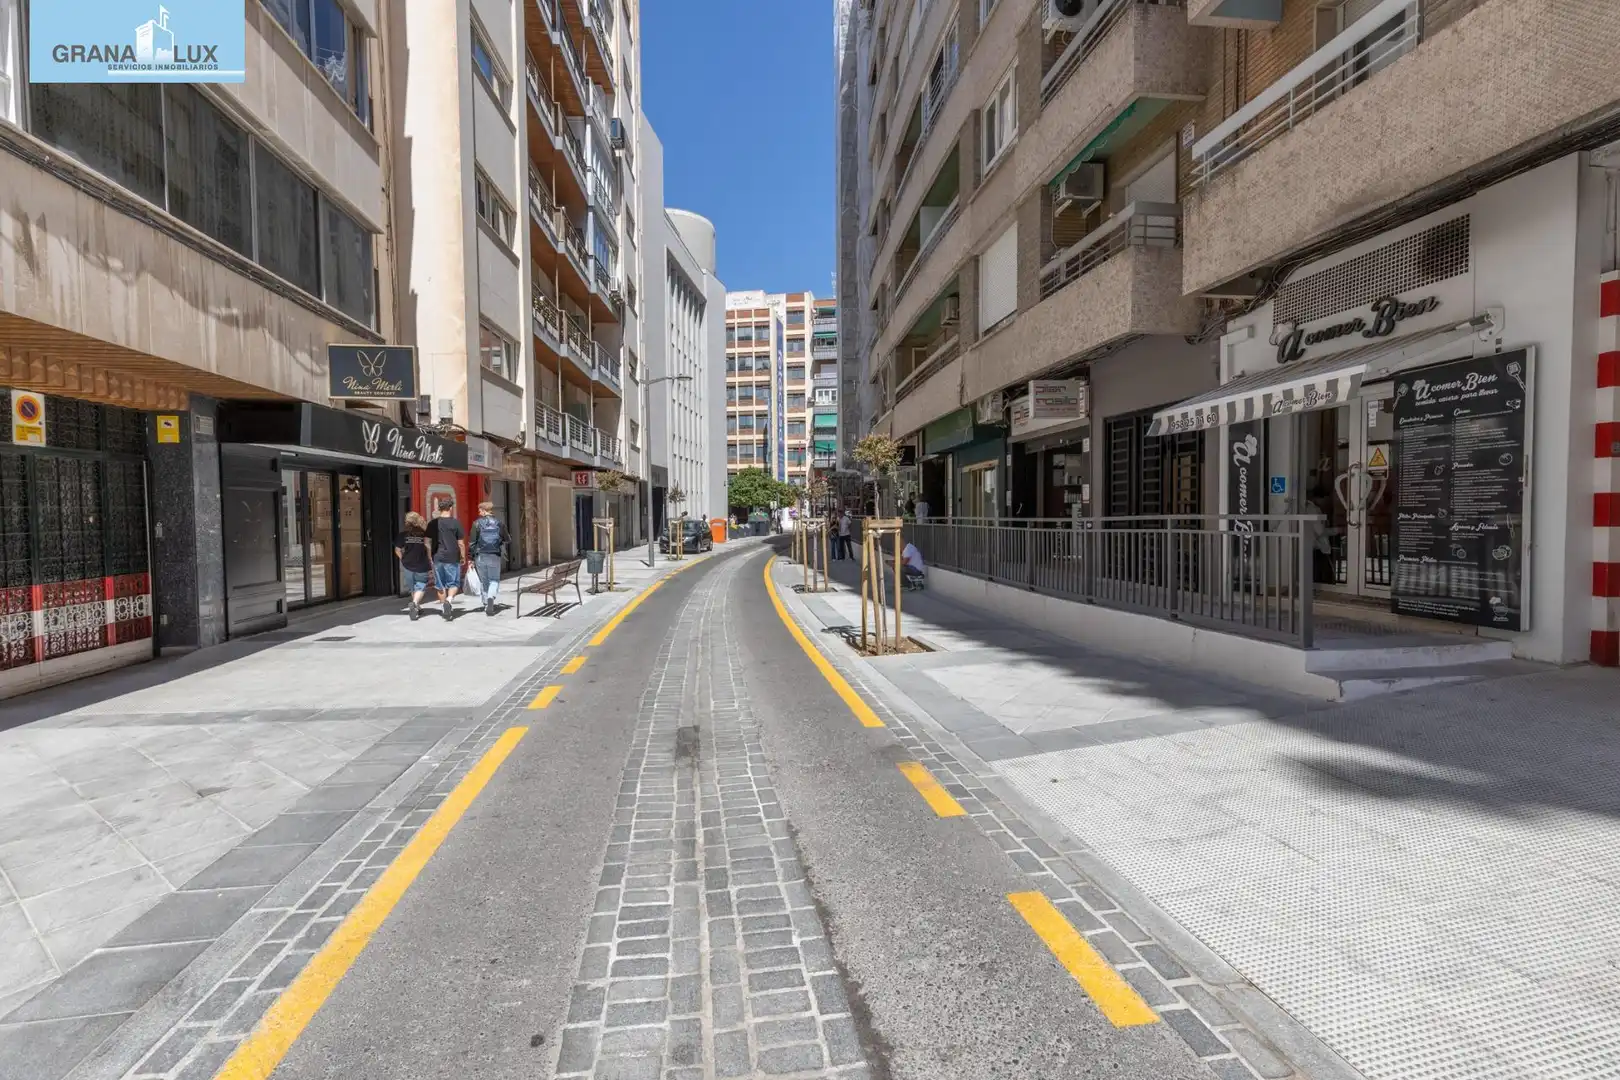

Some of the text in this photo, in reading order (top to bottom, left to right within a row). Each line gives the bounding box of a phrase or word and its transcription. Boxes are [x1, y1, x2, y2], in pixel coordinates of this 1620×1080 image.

[1304, 317, 1365, 346] comer
[1362, 295, 1440, 338] Bien
[342, 376, 370, 390] Nina
[1430, 380, 1463, 392] comer
[1461, 372, 1498, 392] Bien
[1305, 391, 1333, 408] Bien
[1171, 419, 1185, 430] 958
[1185, 417, 1194, 427] 25
[1206, 413, 1217, 423] 60
[387, 427, 416, 459] Nina
[1240, 467, 1248, 515] comer
